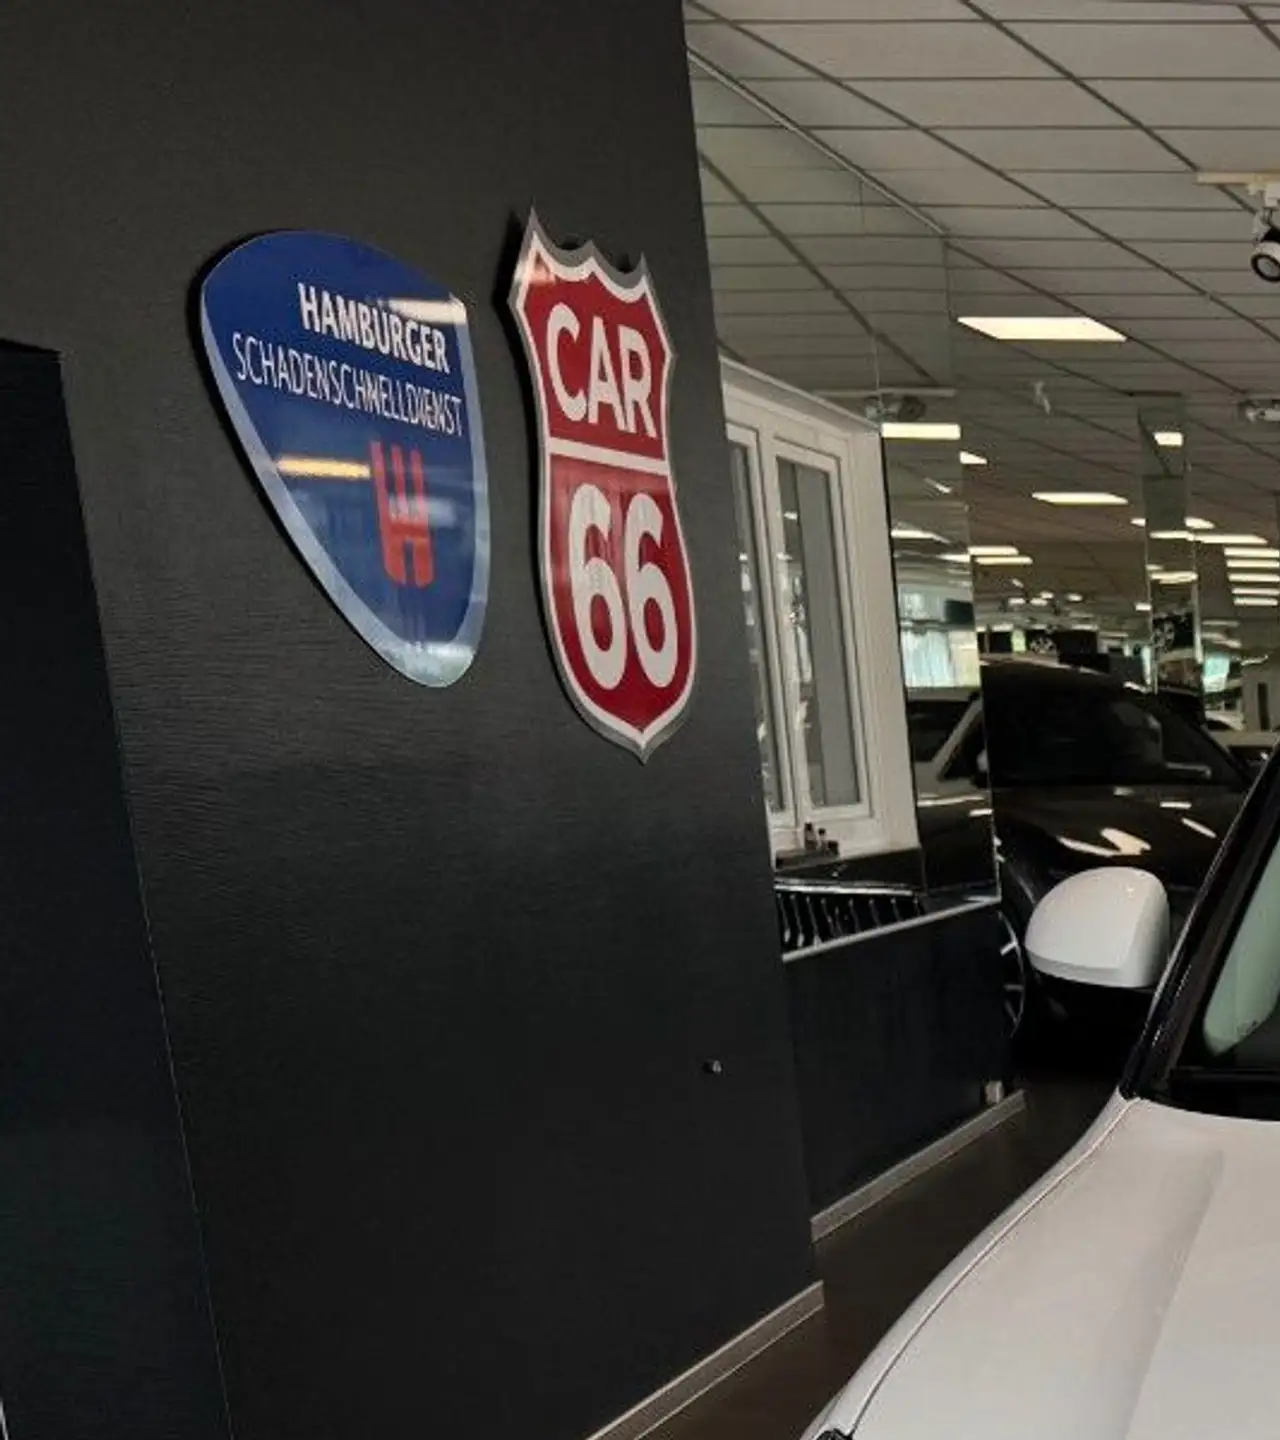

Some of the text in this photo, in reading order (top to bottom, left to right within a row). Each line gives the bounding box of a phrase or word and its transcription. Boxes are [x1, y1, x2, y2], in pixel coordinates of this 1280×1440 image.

[231, 331, 463, 437] SCHADENSCHNELLDIENST
[297, 283, 450, 374] HAMBURGER
[546, 303, 657, 439] CAR
[568, 483, 679, 689] 66
